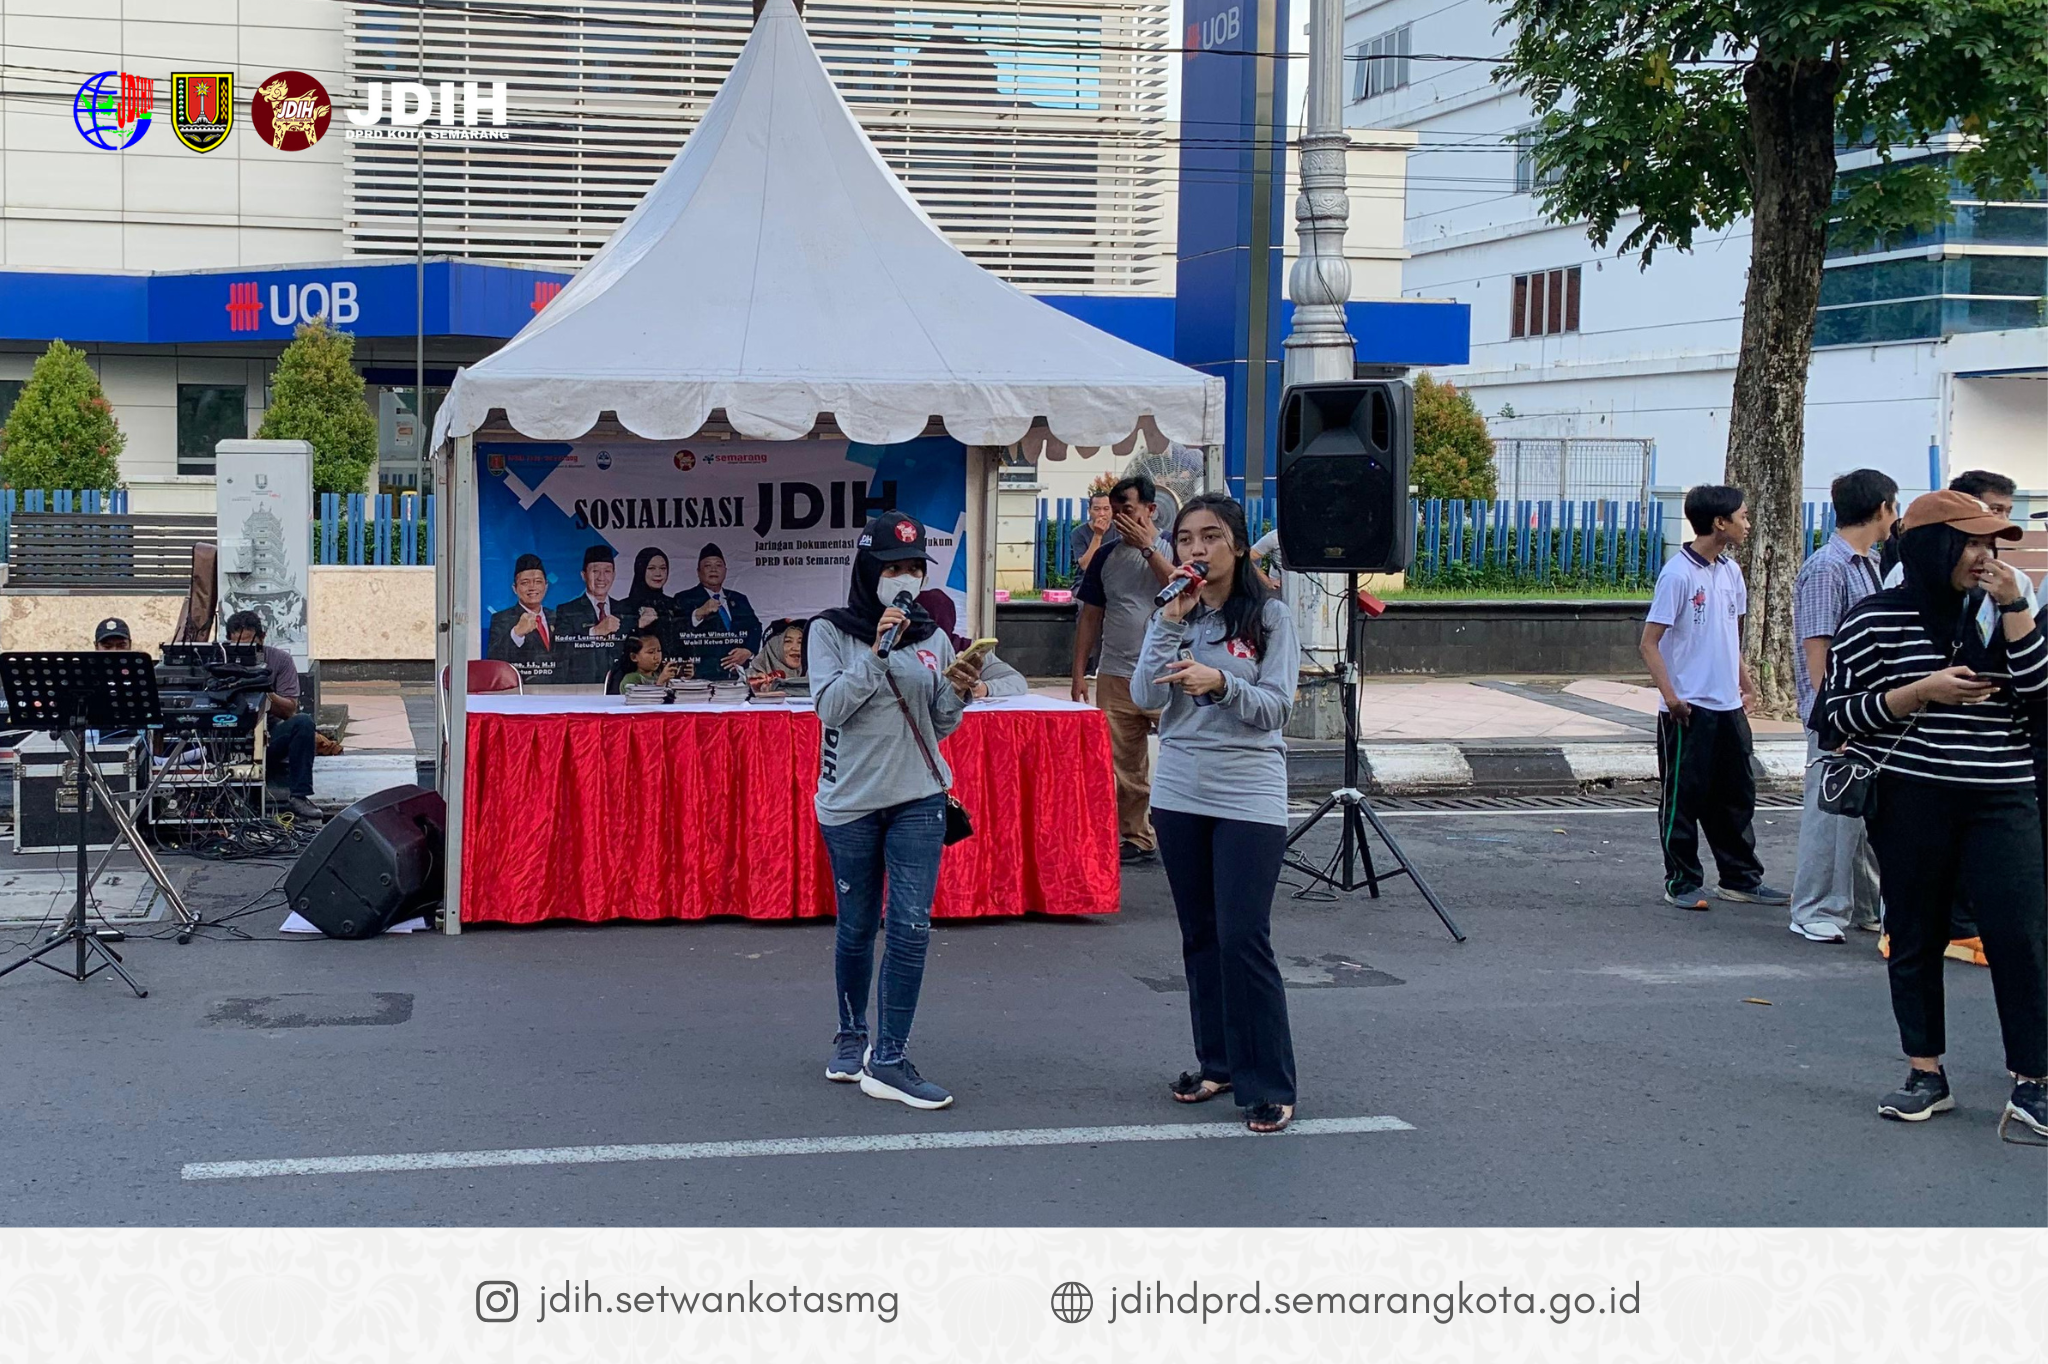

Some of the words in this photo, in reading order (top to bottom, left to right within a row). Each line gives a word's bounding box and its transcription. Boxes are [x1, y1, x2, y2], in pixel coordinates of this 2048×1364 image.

[1203, 6, 1240, 50] UOB
[270, 281, 360, 326] UOB
[715, 454, 767, 463] semarang
[574, 496, 745, 530] SOSIALISASI
[753, 480, 897, 538] JDIH
[754, 541, 794, 551] Jaringan
[797, 538, 854, 550] Dokumentasi
[755, 556, 781, 567] DPRD
[783, 555, 803, 566] Kota
[806, 554, 850, 567] Semarang
[823, 728, 839, 784] DIH
